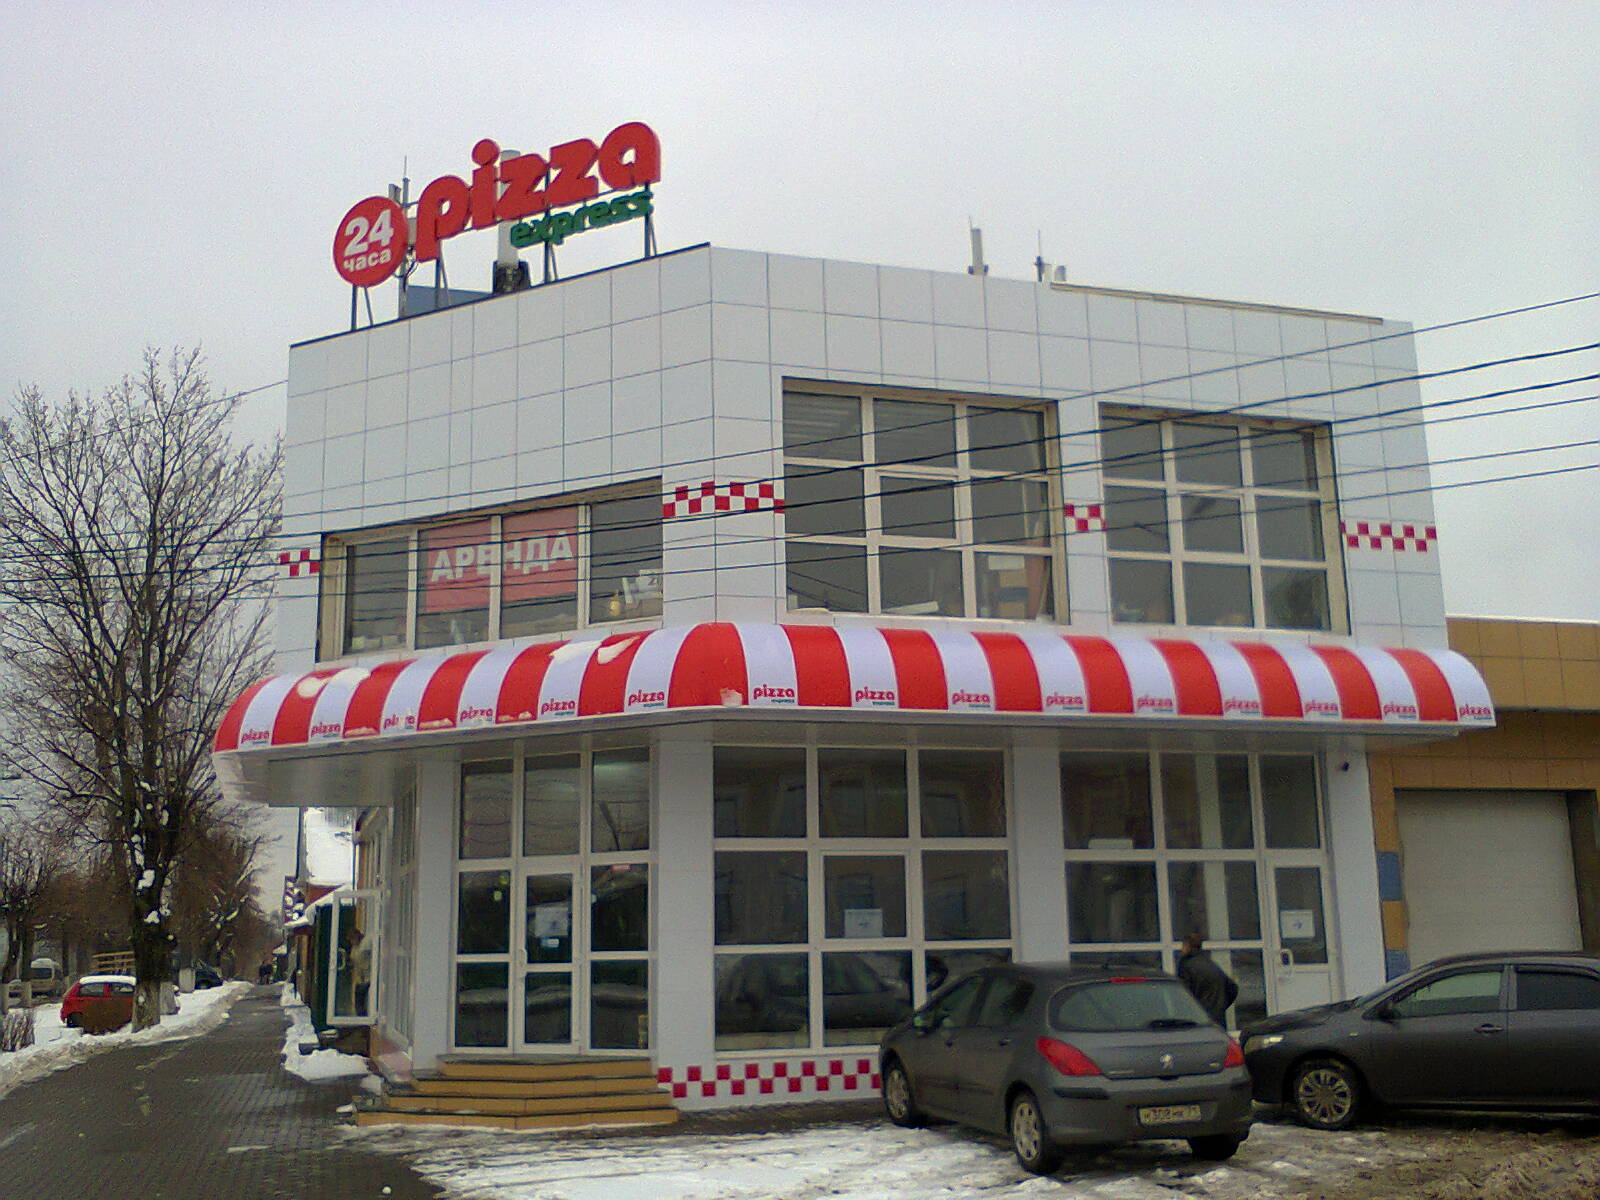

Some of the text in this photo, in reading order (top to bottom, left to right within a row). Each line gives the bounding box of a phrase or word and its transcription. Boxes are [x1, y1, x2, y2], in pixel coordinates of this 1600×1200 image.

[416, 121, 661, 263] pizza
[510, 190, 654, 249] express
[344, 209, 394, 256] 24
[343, 248, 392, 272] часа
[431, 531, 573, 582] АРЕНДА
[628, 690, 665, 706] pizza
[753, 683, 795, 700] pizza
[855, 686, 895, 702] pizza
[952, 689, 990, 704] pizza
[1046, 692, 1084, 706] pizza
[460, 705, 493, 722] pizza
[541, 698, 576, 715] pizza
[241, 728, 271, 743] pizza
